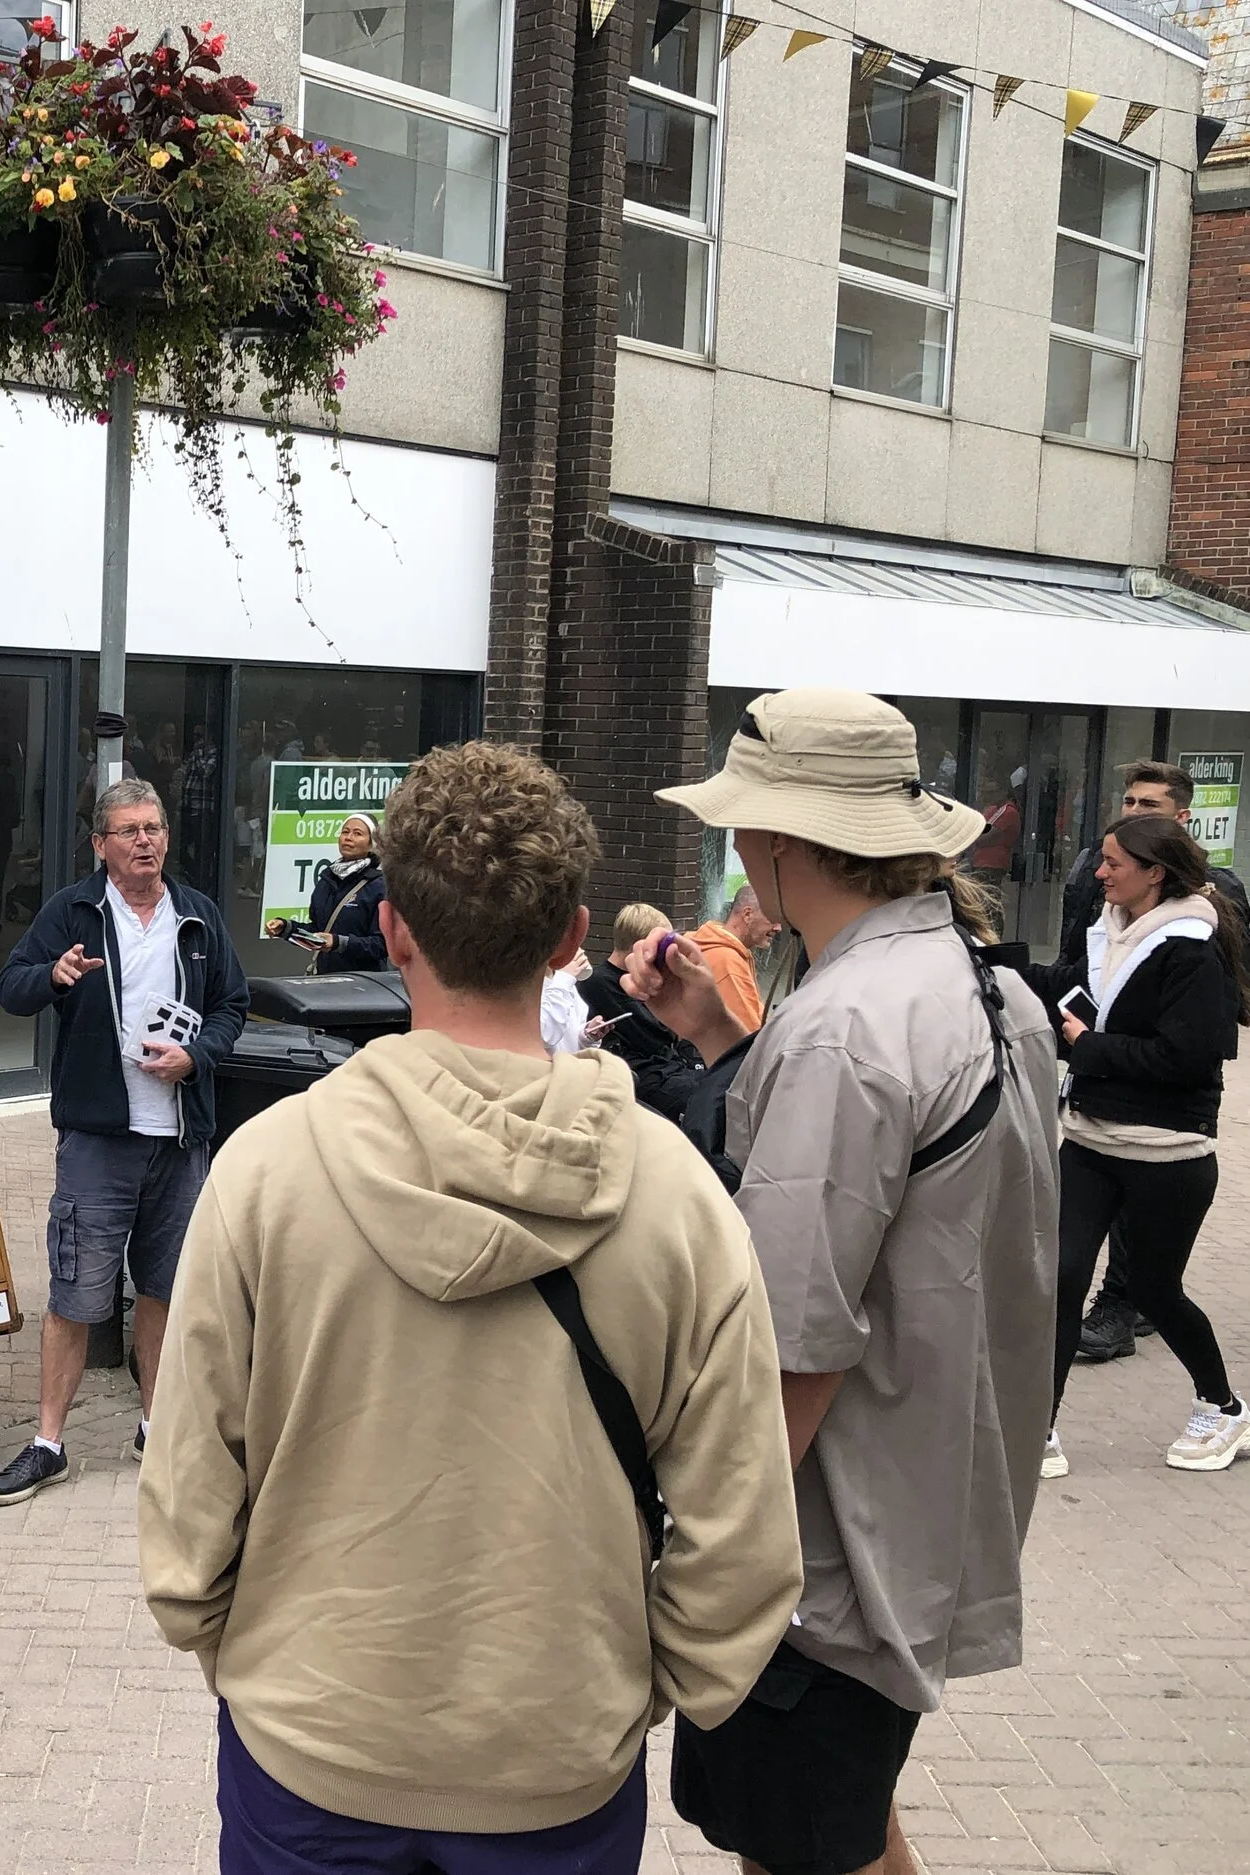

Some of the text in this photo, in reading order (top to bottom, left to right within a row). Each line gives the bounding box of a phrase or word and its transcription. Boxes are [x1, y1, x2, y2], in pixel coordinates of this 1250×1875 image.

[1189, 756, 1234, 783] alder king
[297, 767, 356, 801] alder
[1209, 790, 1232, 804] 222174
[296, 819, 342, 839] 01872
[1186, 816, 1229, 841] TO LET
